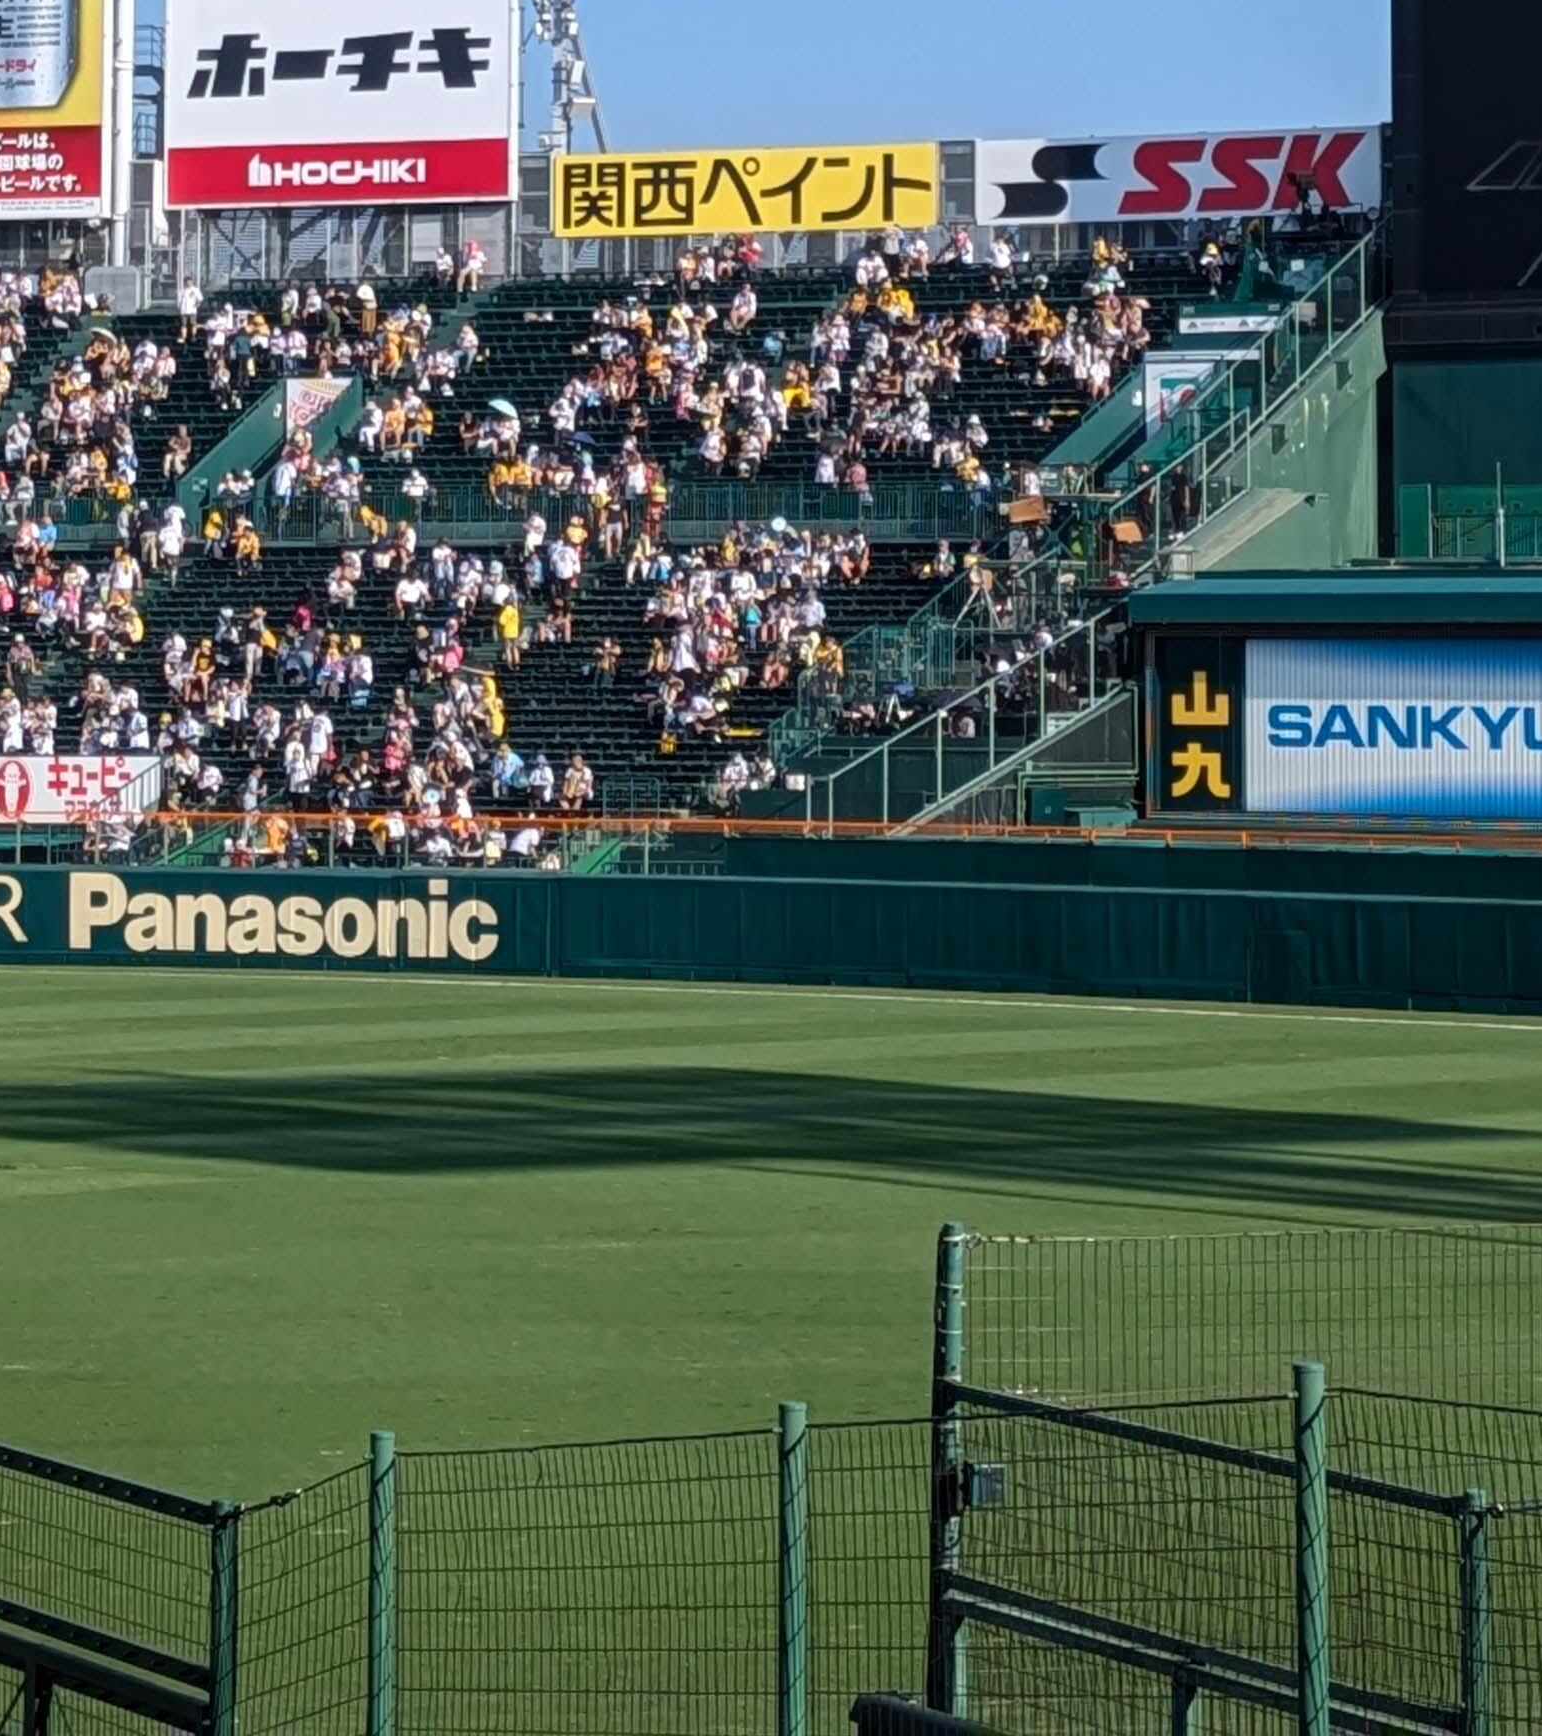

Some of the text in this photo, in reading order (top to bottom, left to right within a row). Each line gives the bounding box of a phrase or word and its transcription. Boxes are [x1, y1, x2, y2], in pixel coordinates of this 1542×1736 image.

[186, 26, 492, 99] ホーチキ
[274, 157, 427, 186] HOCHIKI
[563, 151, 933, 230] 関西ペイント
[1117, 132, 1367, 215] SSK
[1170, 670, 1231, 798] 山九
[47, 751, 132, 798] キューピー
[68, 870, 499, 961] Panasonic
